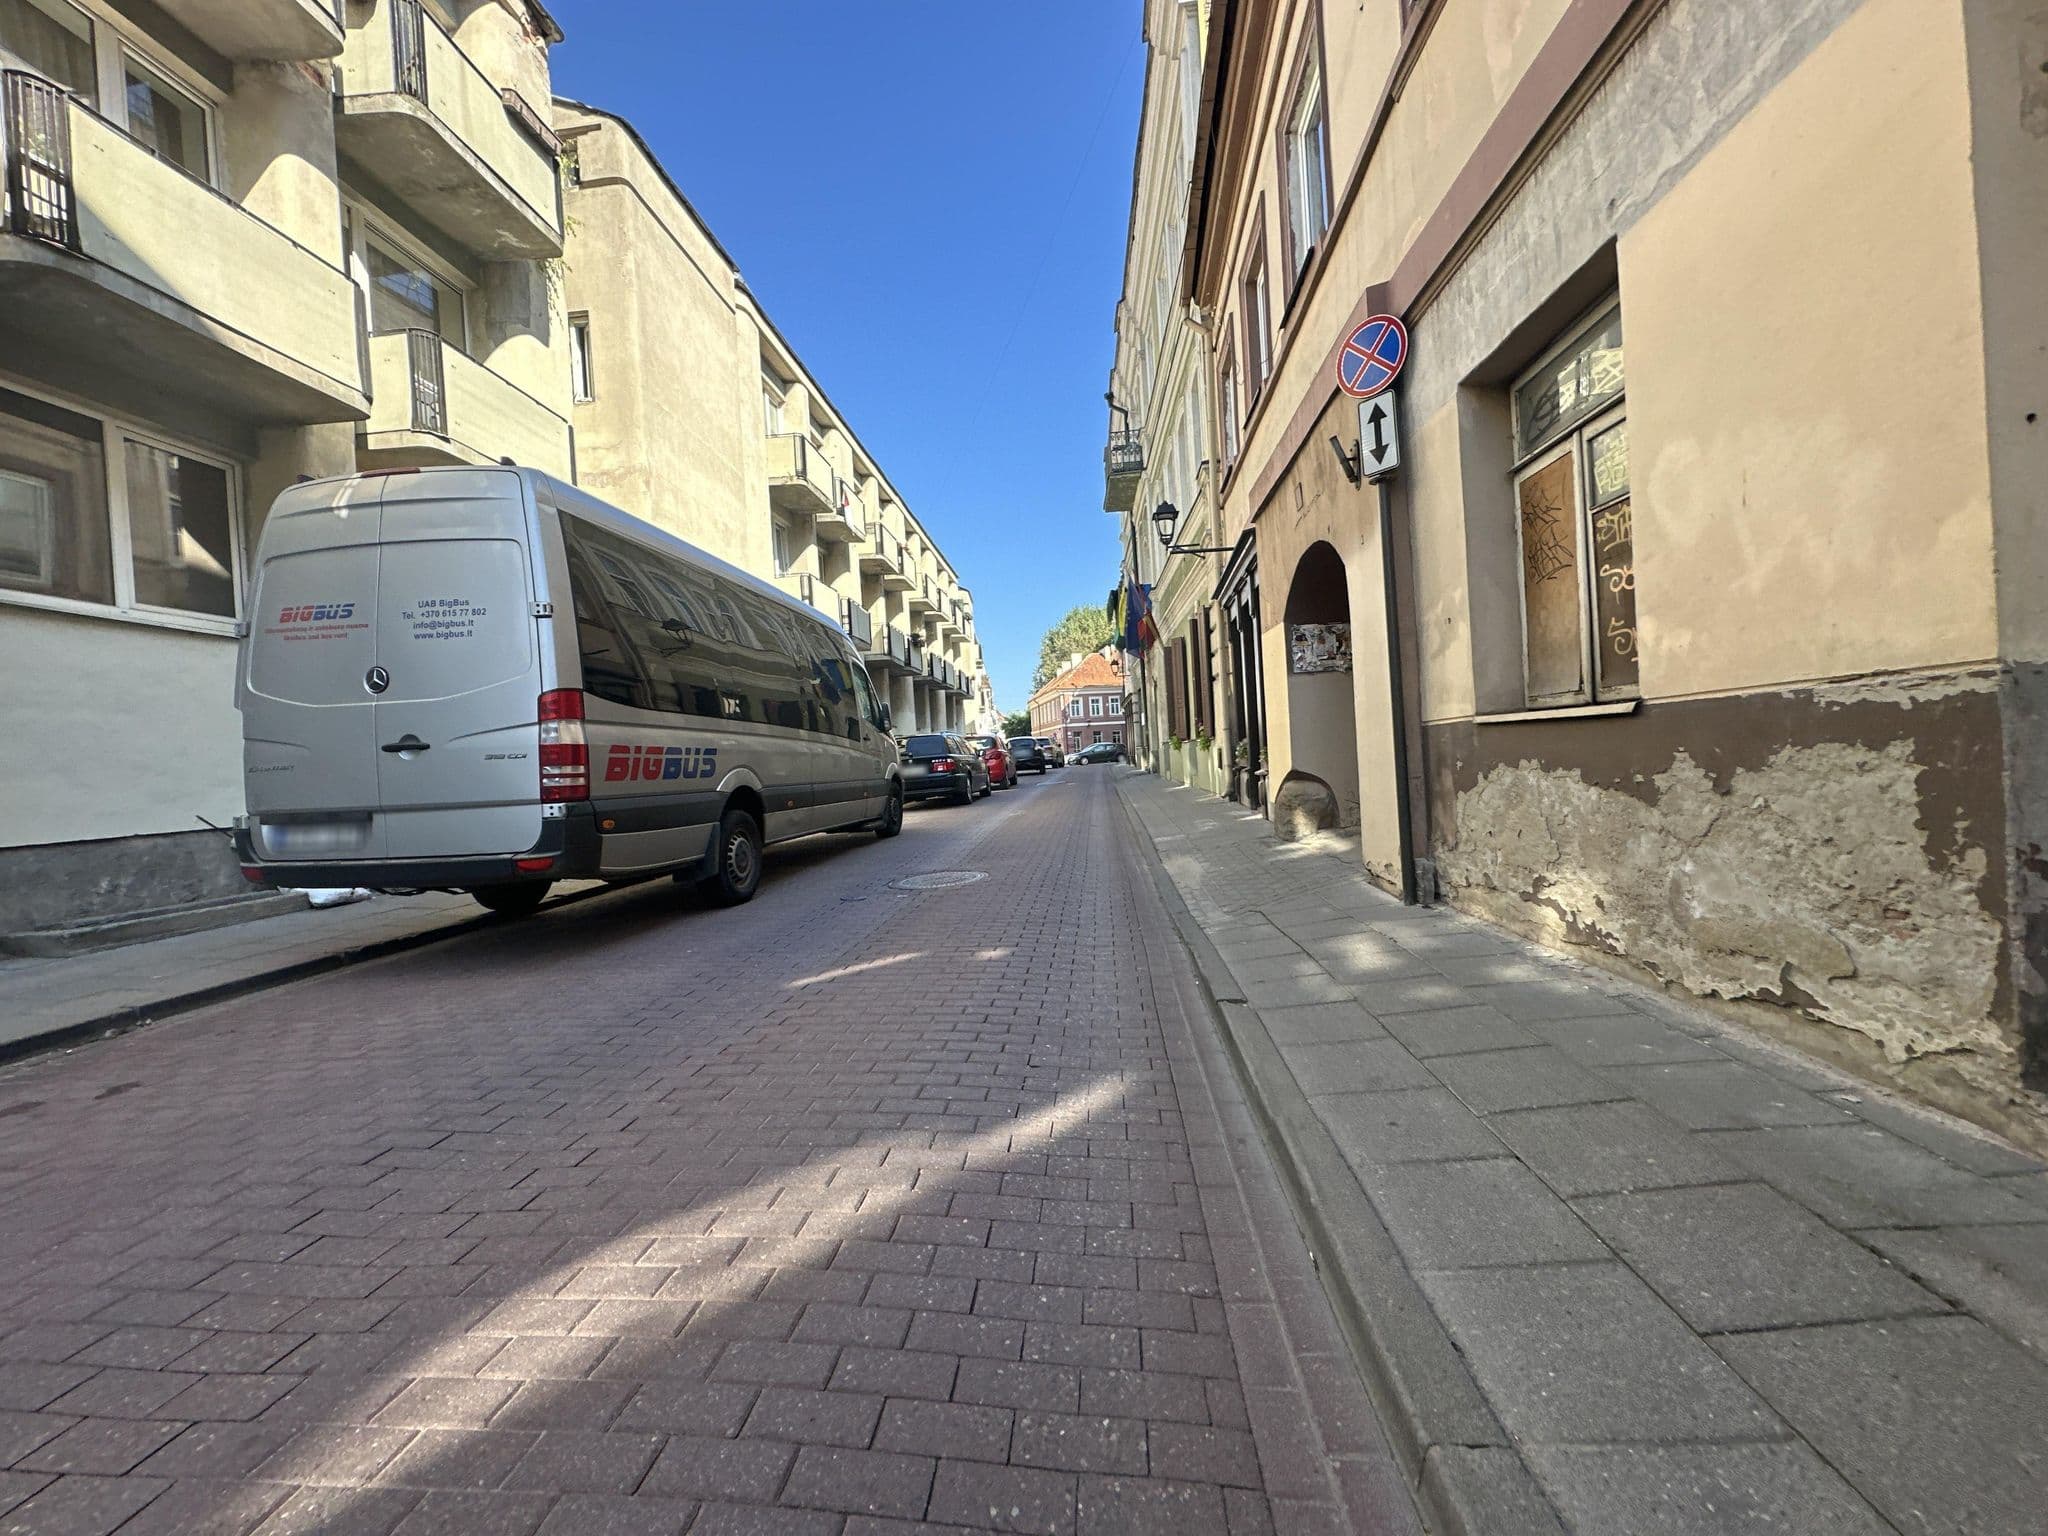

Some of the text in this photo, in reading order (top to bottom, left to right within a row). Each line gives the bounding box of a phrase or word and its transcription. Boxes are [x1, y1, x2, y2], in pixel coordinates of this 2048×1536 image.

[418, 599, 470, 608] UAB BigBus
[279, 603, 356, 623] BIGBUS
[401, 608, 487, 619] Tel. +370 615 77 802
[413, 619, 474, 630] info@bigbus.lt
[413, 630, 473, 640] www.bigbus.lt
[604, 744, 718, 782] BIGBUS
